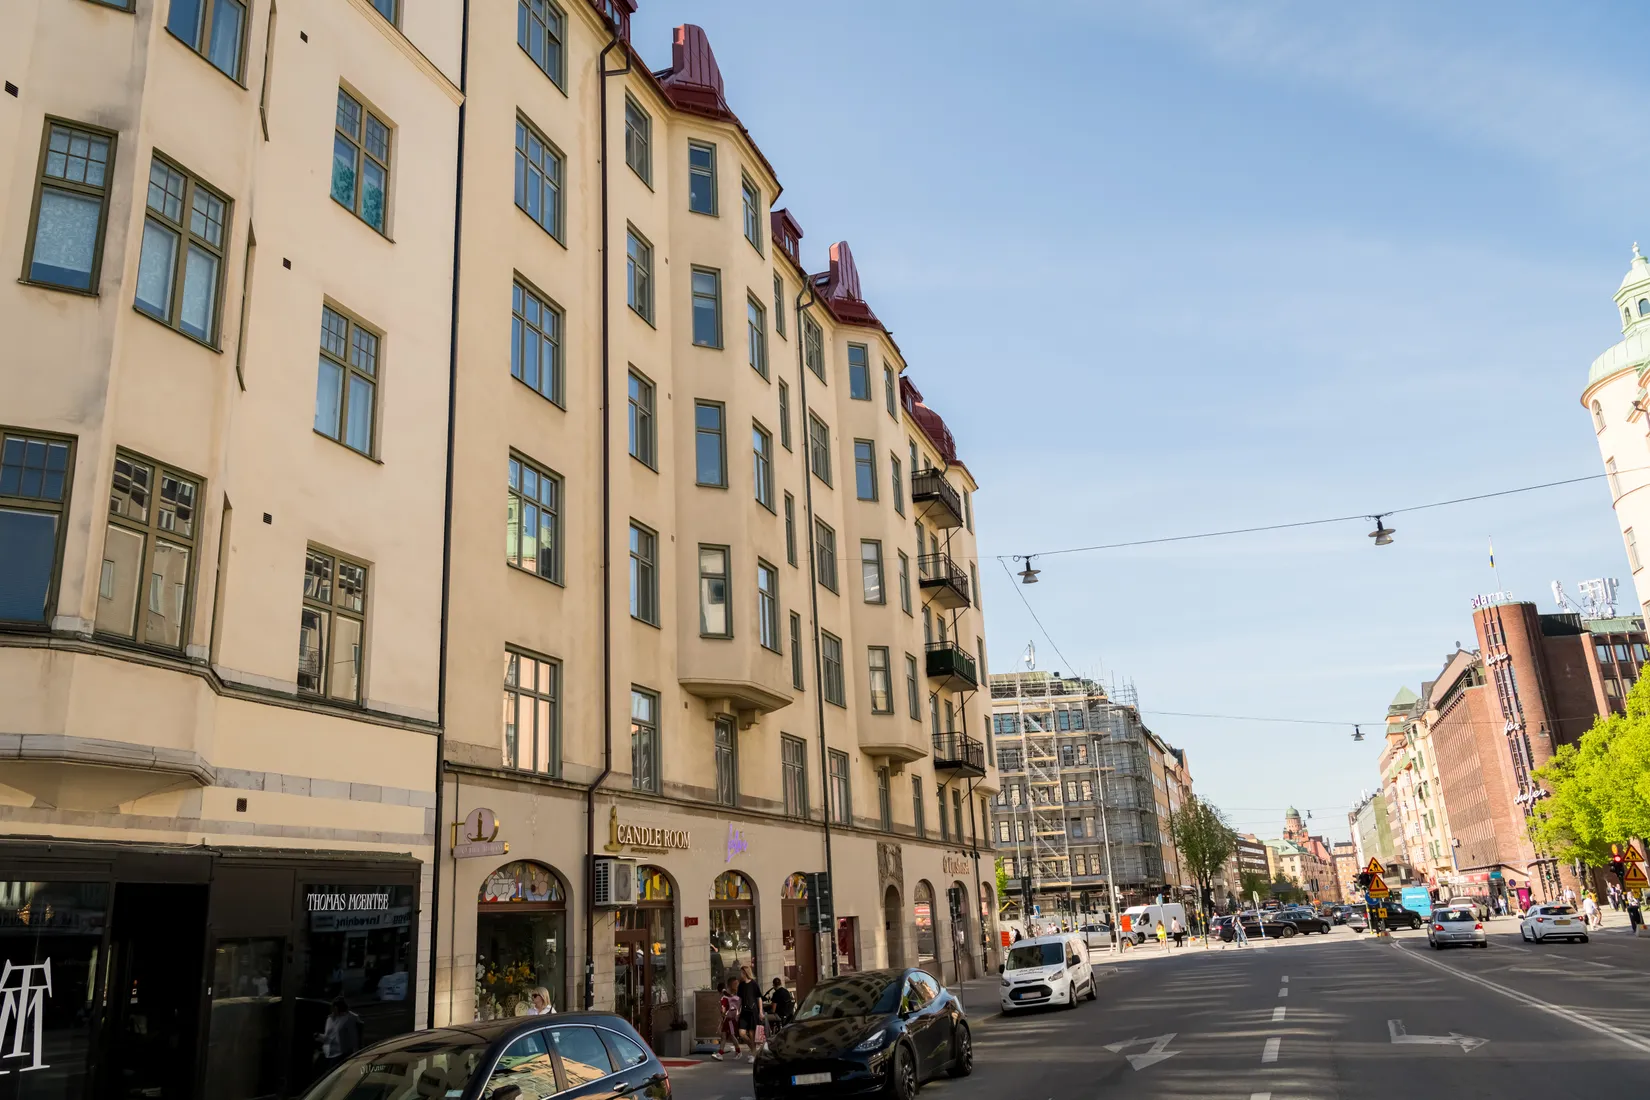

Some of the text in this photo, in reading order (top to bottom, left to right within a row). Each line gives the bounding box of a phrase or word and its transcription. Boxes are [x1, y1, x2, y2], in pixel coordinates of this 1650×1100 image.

[1486, 652, 1508, 666] bara
[1513, 786, 1546, 805] chefer
[617, 824, 691, 849] CANDLE ROOM
[306, 892, 346, 911] THOMAS
